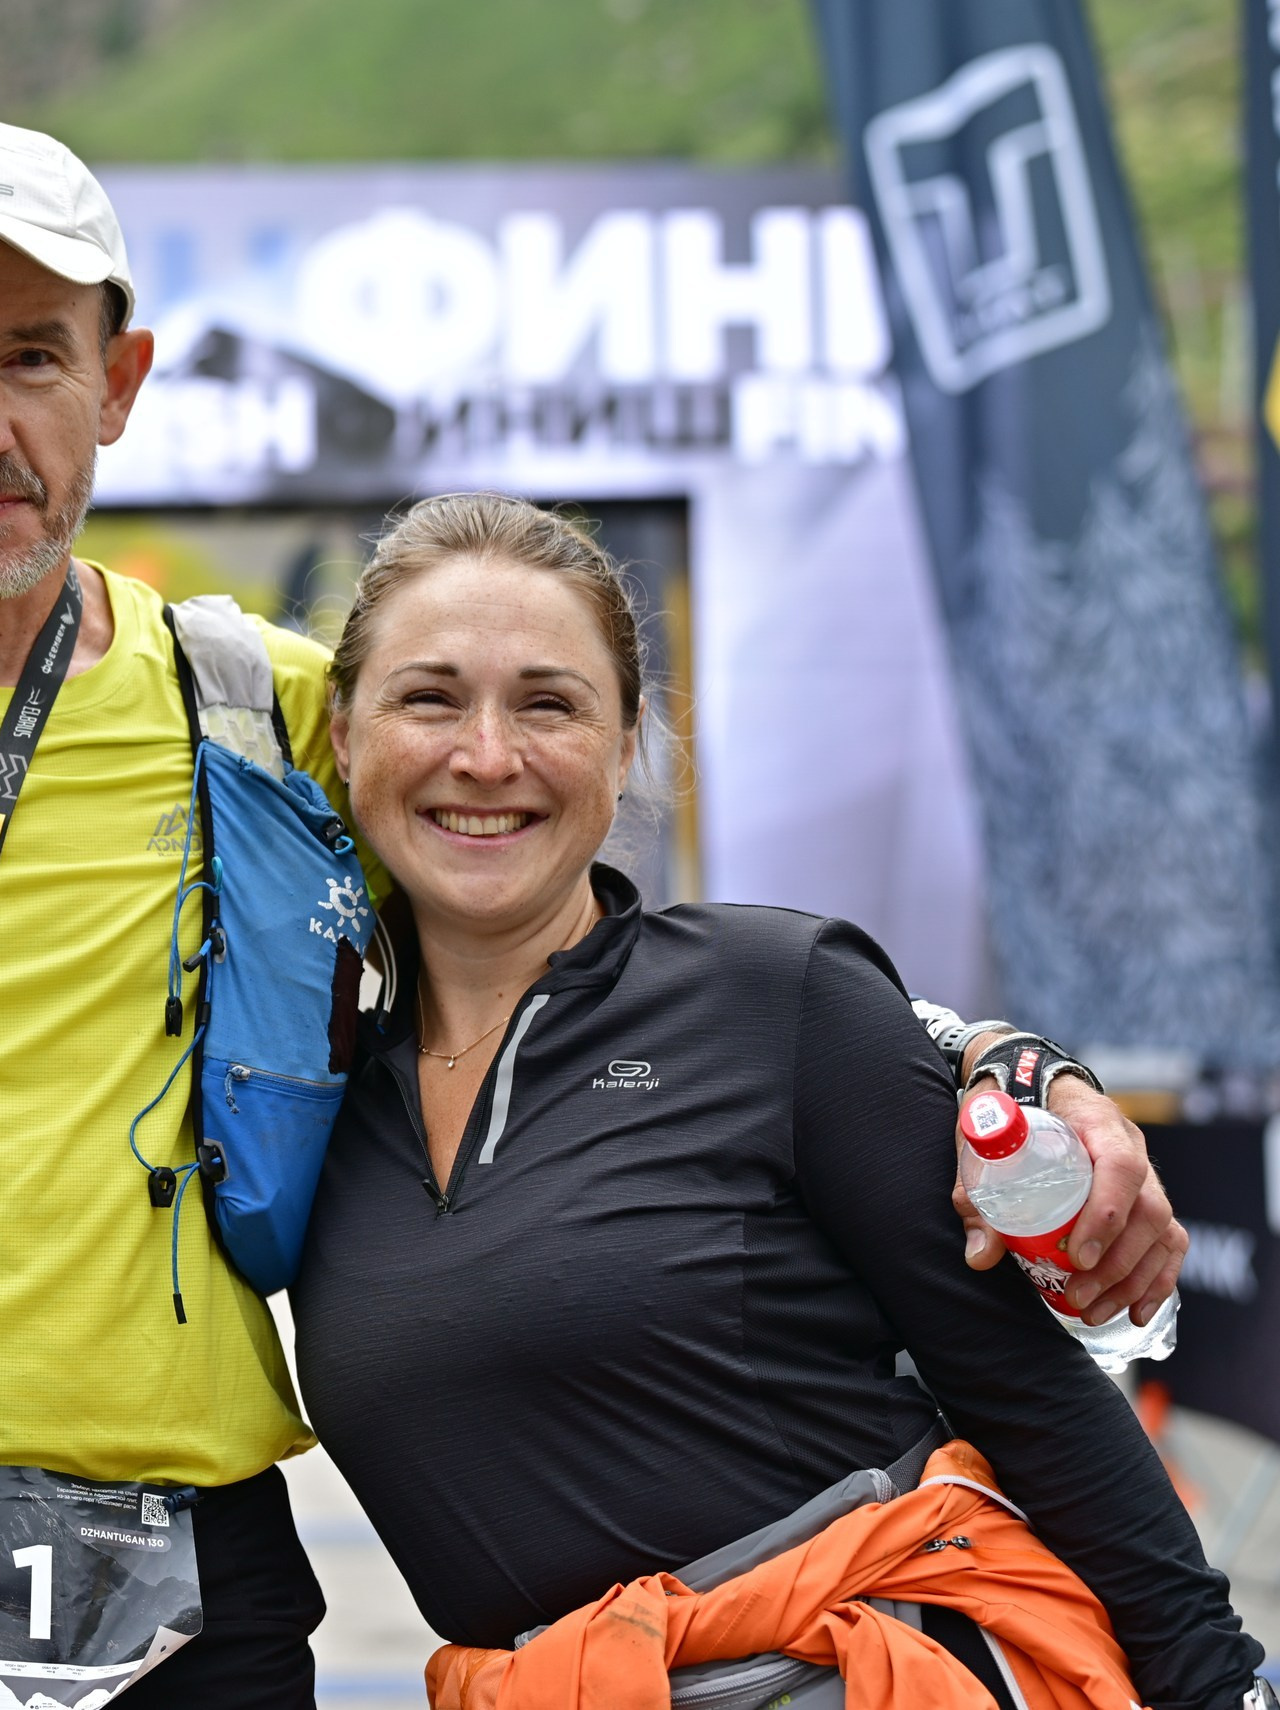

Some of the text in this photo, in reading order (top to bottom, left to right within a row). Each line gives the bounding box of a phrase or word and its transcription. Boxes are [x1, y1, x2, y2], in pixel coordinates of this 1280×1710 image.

[13, 706, 41, 738] ELBRUS
[592, 1078, 660, 1091] Kalenji
[80, 1527, 164, 1548] DZHANTUGAN 130
